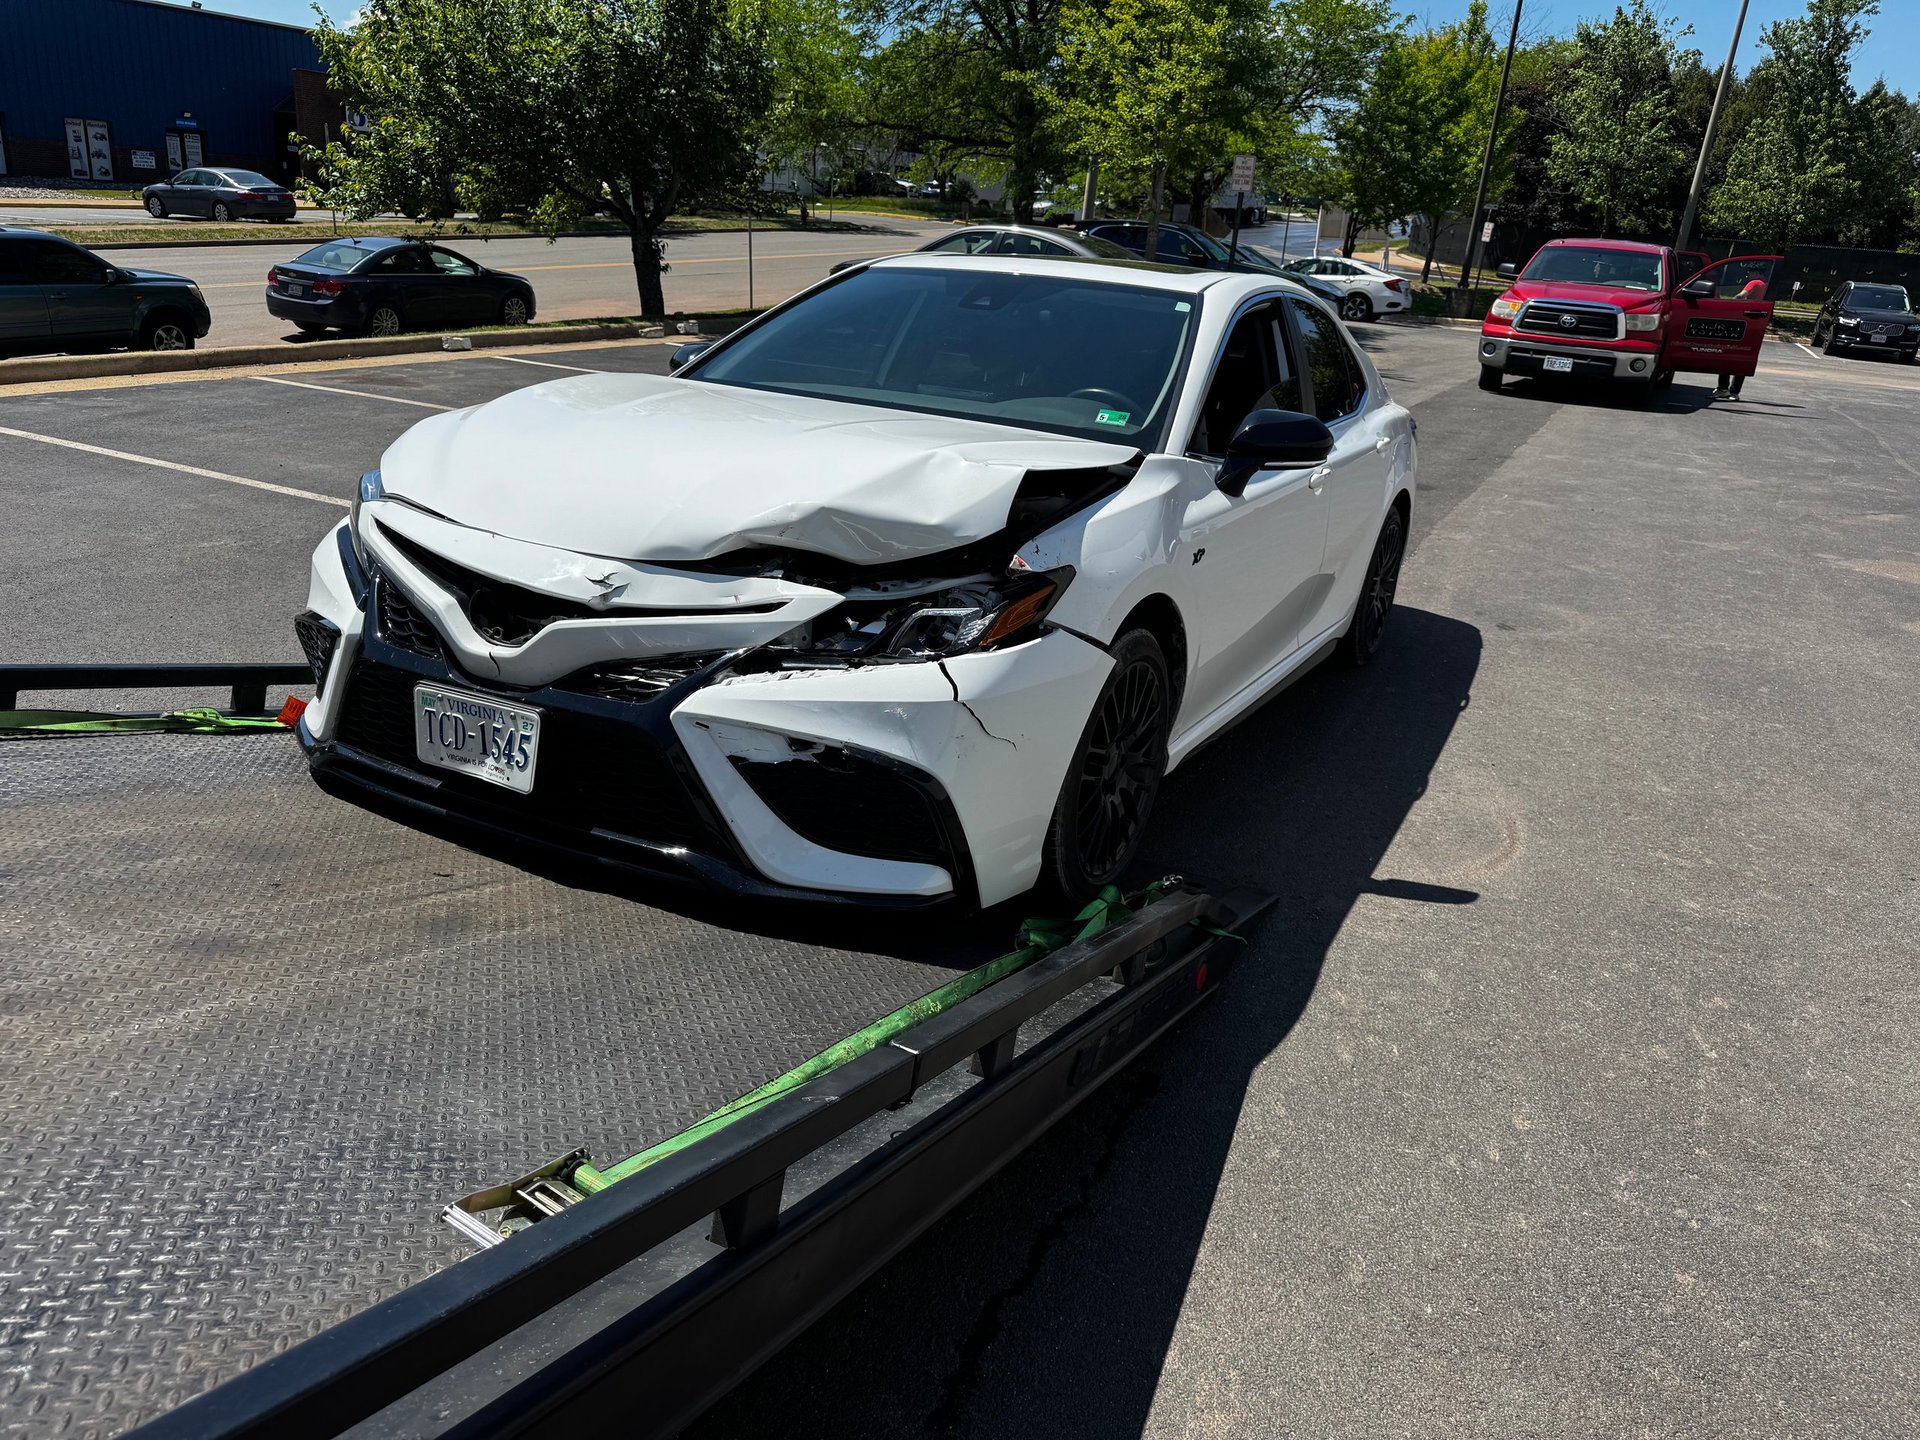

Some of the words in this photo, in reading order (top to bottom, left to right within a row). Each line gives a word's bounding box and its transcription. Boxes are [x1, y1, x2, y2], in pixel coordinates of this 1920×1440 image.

[421, 695, 436, 708] MAY
[447, 698, 506, 725] VIRGINIA
[522, 720, 534, 732] 27
[423, 707, 532, 770] TCD-1545
[446, 752, 471, 765] VIRGINIA
[477, 760, 488, 768] FOR
